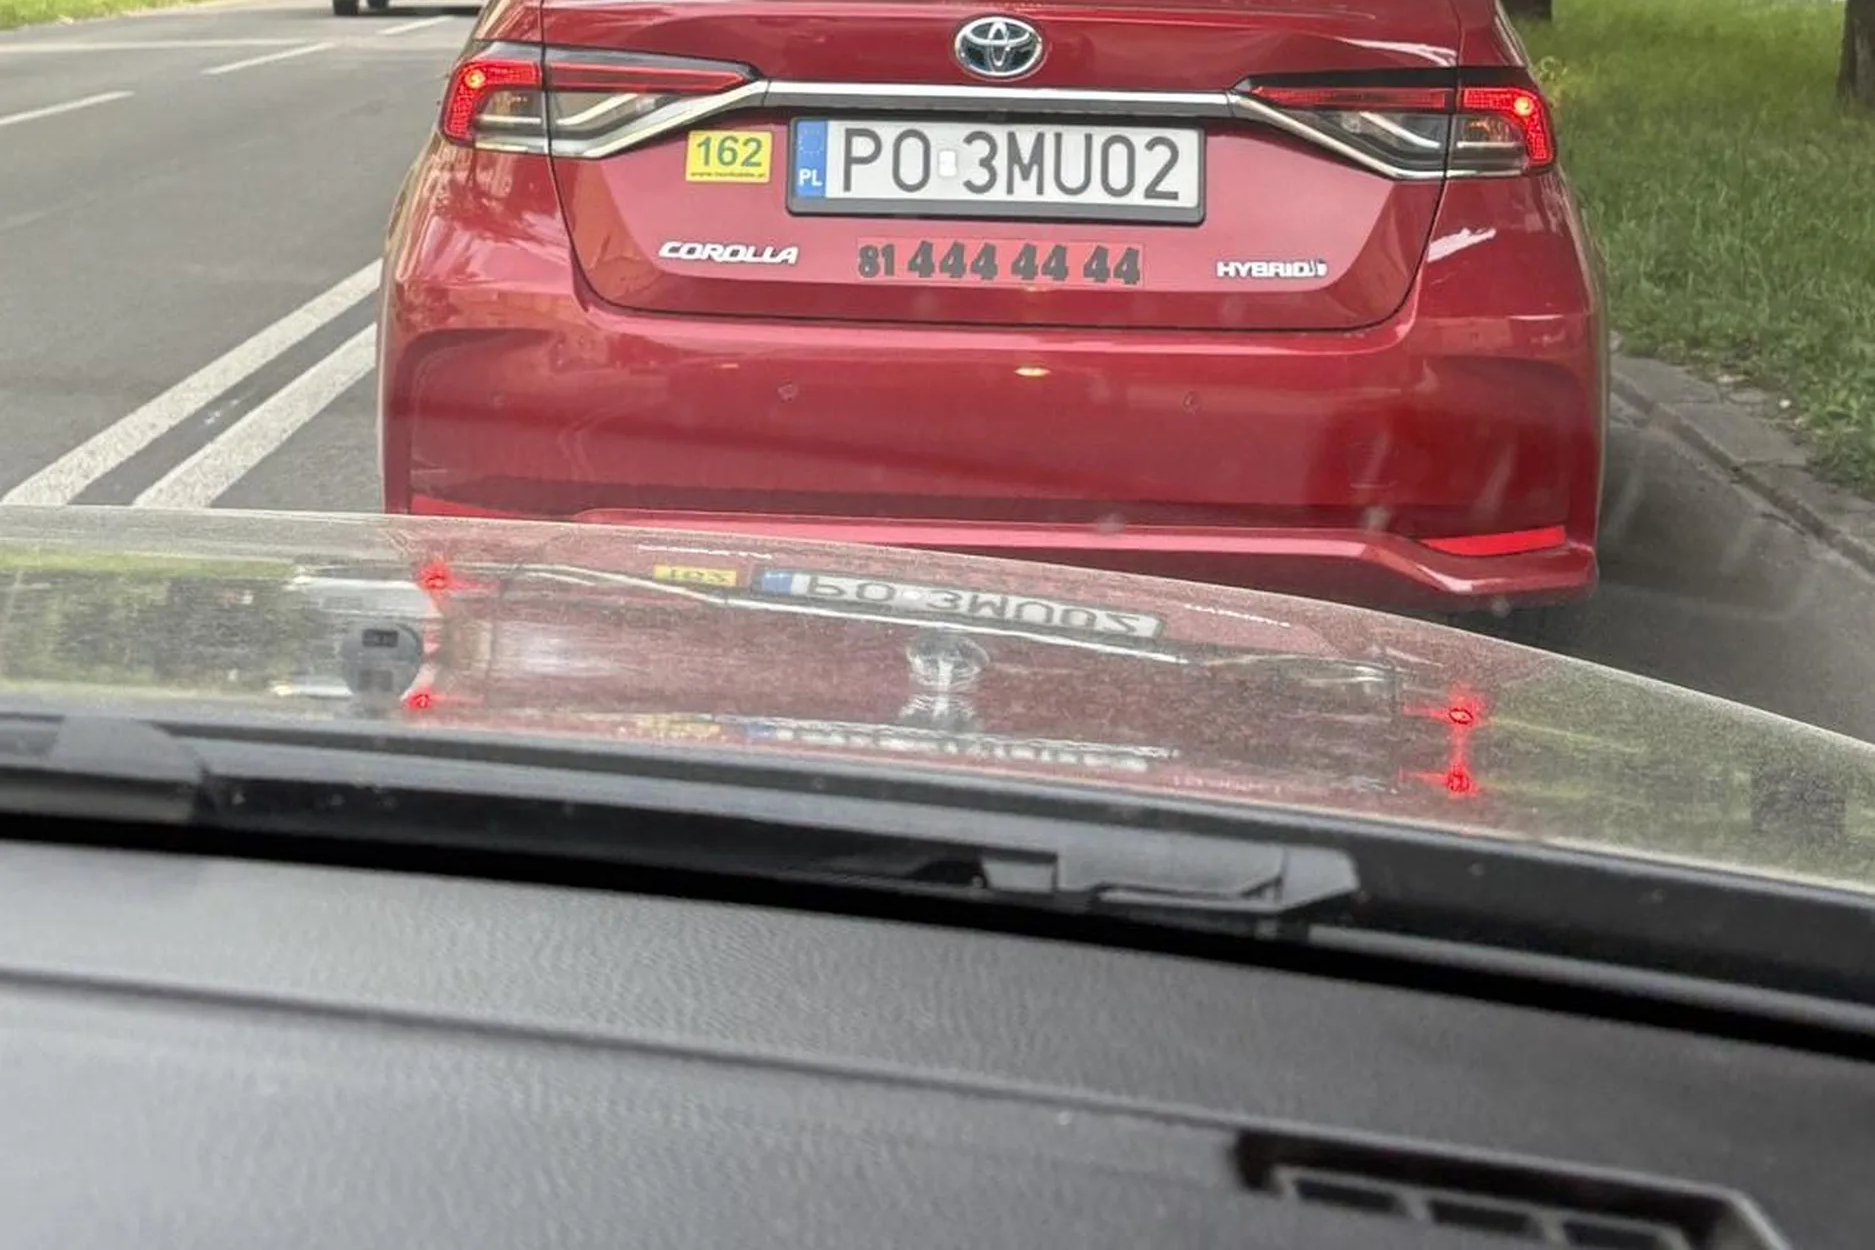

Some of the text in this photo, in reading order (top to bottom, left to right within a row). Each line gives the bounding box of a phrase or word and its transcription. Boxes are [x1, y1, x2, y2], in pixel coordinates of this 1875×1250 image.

[697, 136, 763, 167] 162
[843, 128, 1180, 201] PO 3MU02
[798, 168, 824, 187] PL
[659, 241, 799, 265] COROLLA
[858, 240, 1141, 285] 81 444 44 44
[1216, 261, 1312, 278] HYBRID
